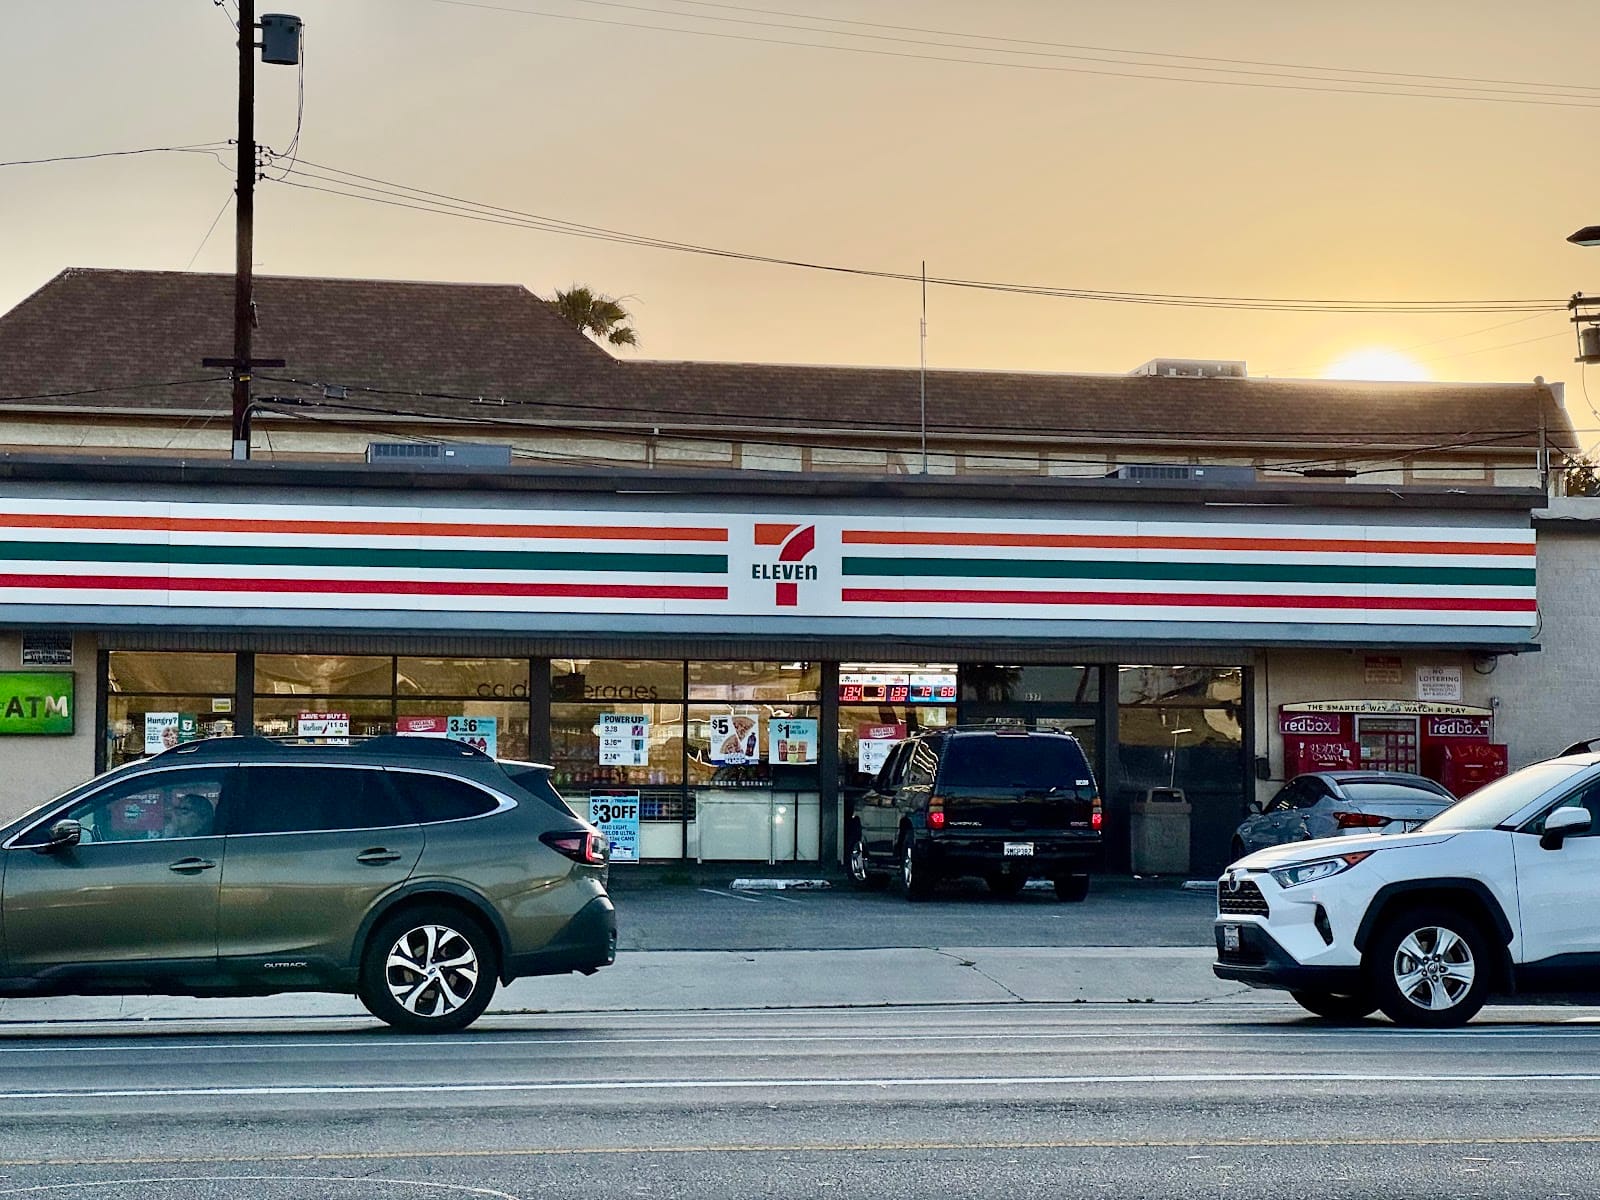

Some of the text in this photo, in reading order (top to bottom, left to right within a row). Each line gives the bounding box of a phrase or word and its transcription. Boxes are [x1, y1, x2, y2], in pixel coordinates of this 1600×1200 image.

[1418, 675, 1460, 683] LOITERING
[843, 686, 861, 697] 134
[877, 687, 885, 697] 9
[890, 687, 908, 697] 139
[919, 686, 931, 697] 72
[940, 687, 955, 697] 68
[5, 696, 69, 718] ATM
[1326, 704, 1366, 712] SMARTER
[147, 717, 178, 726] Hungry?
[604, 715, 644, 724] POWER UP
[450, 719, 459, 732] 3
[1284, 720, 1332, 732] redbox
[1433, 721, 1482, 735] redbox
